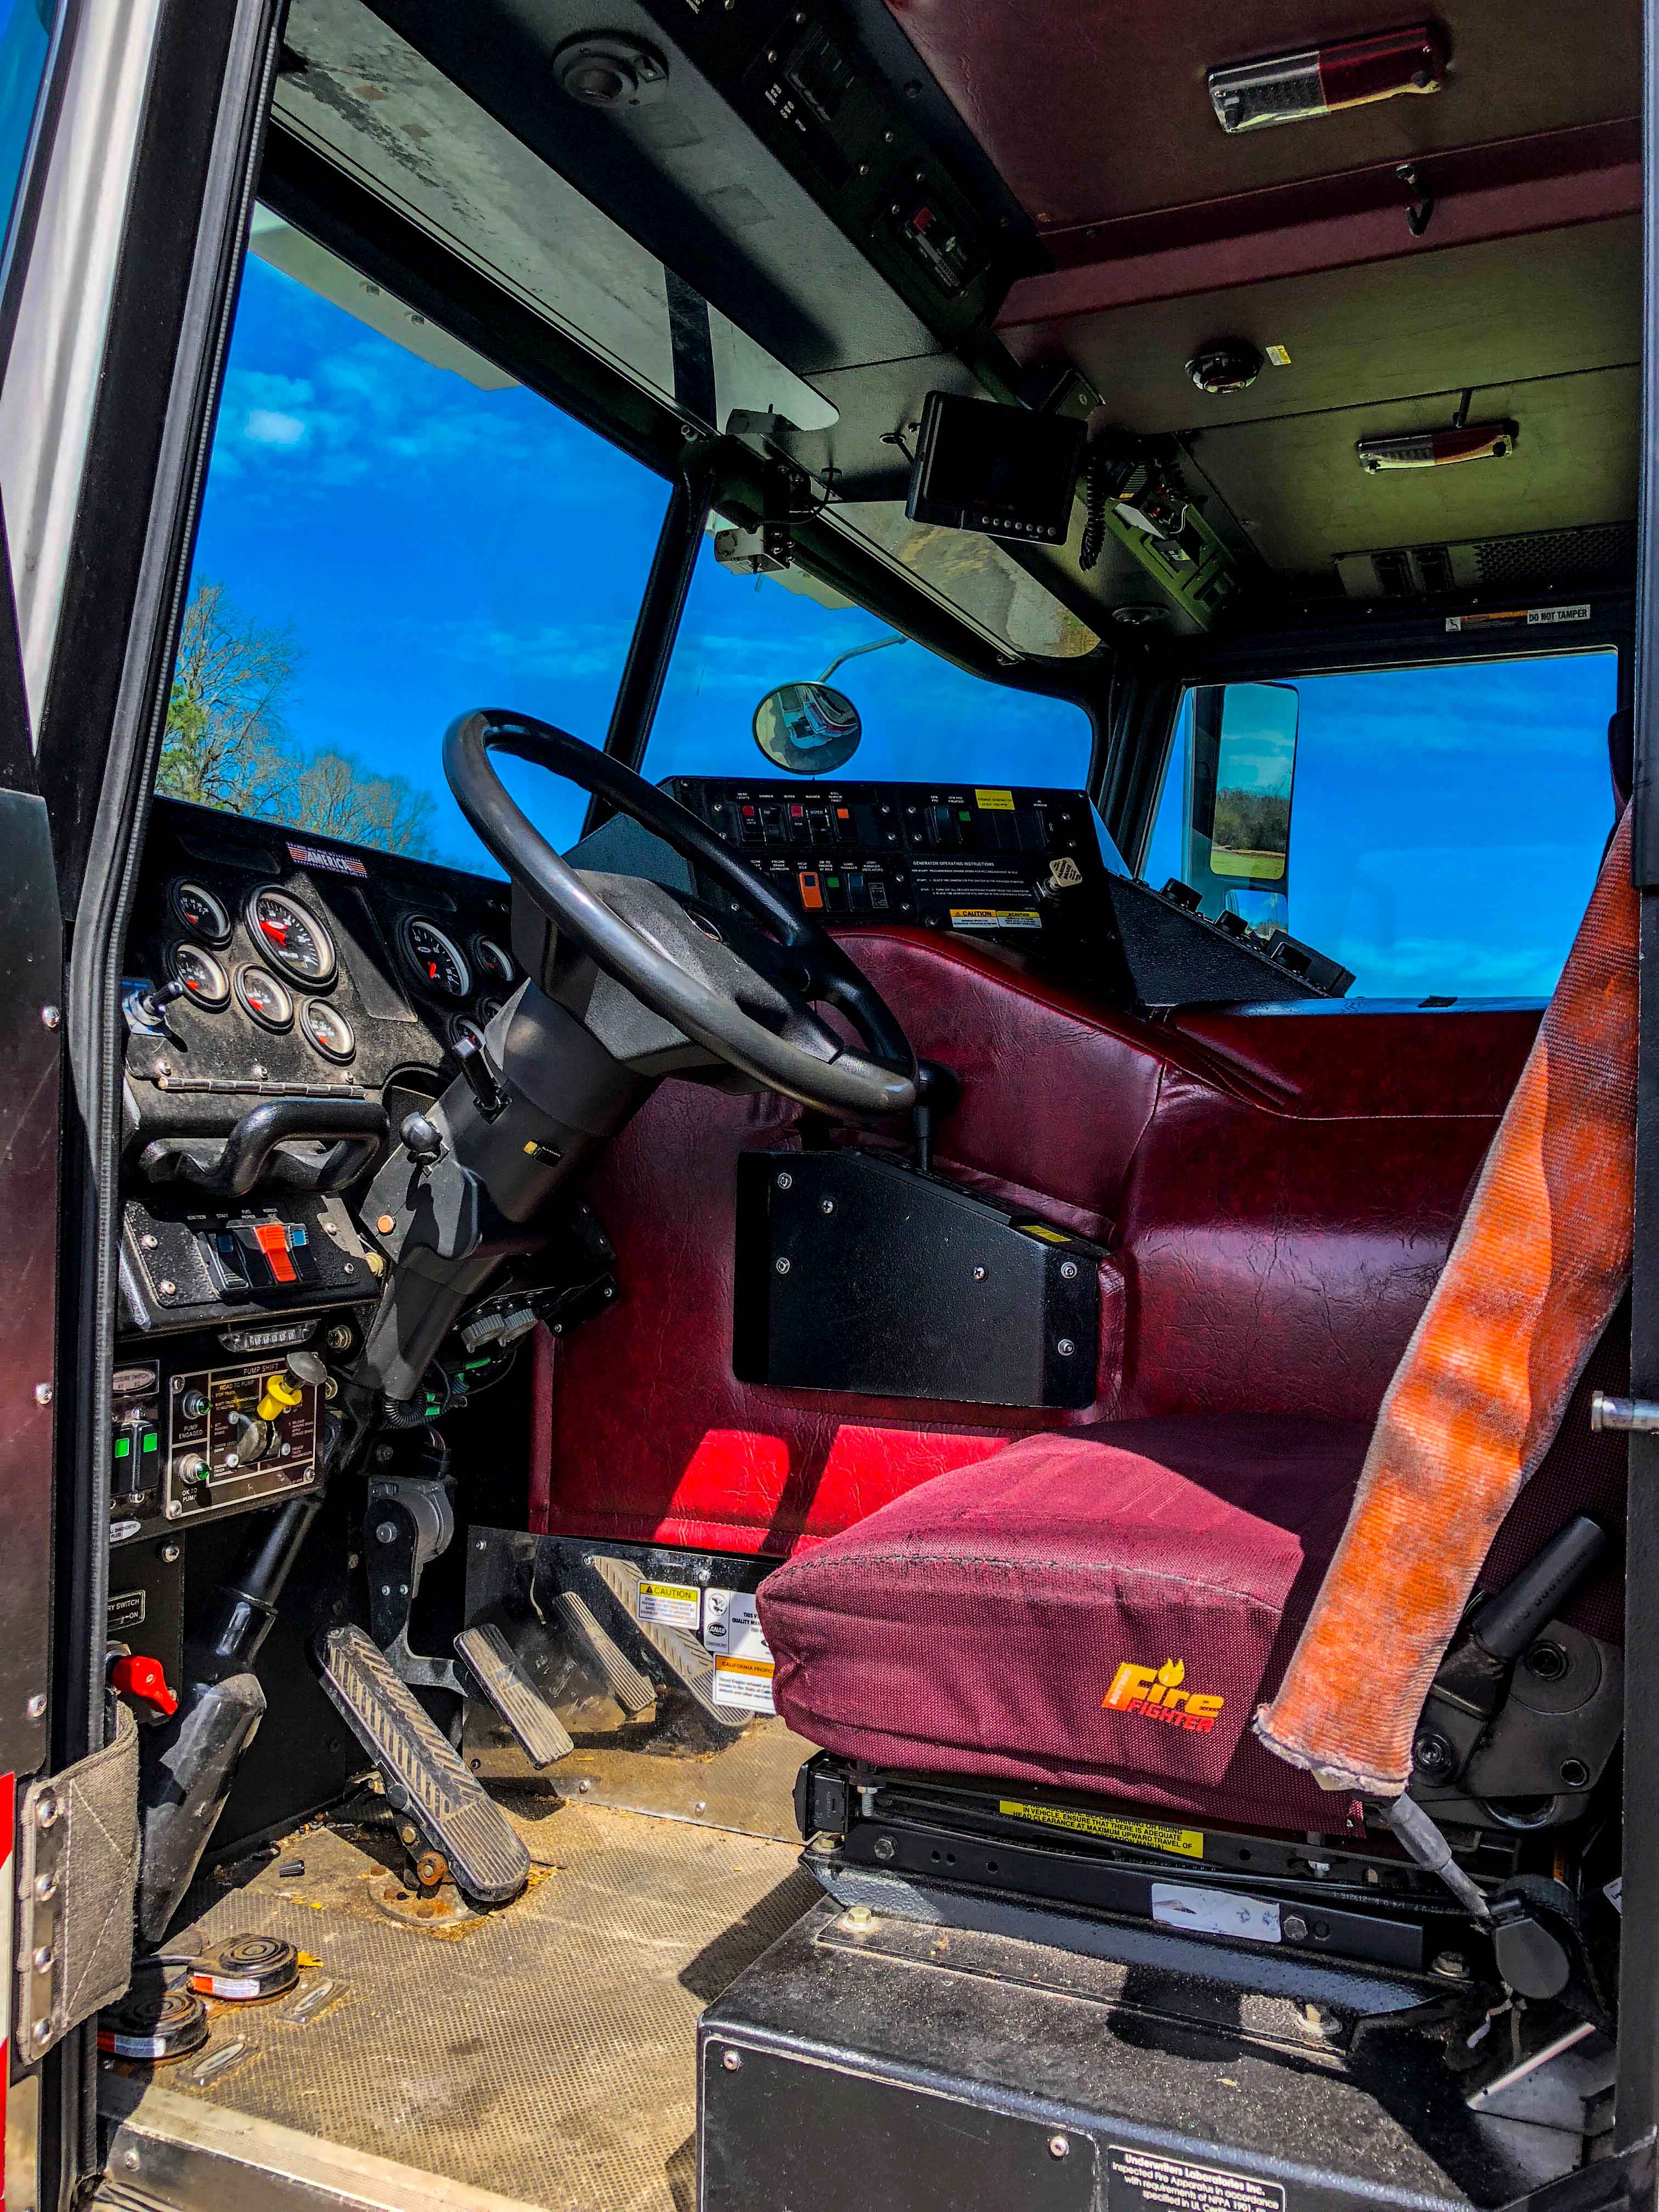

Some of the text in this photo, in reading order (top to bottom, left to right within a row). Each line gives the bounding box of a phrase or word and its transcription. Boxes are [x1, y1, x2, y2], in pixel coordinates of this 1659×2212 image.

[1529, 613, 1538, 622] DO
[1541, 612, 1555, 620] NOT
[1556, 609, 1587, 619] TAMPER
[307, 851, 353, 871] AMERICA
[244, 1363, 279, 1375] PUMP SHIFT
[179, 1430, 203, 1439] ENGAGED
[183, 1494, 198, 1502] PUMP
[654, 1587, 691, 1599] CAUTION
[116, 1599, 140, 1610] SWITCH
[722, 1662, 753, 1670] CALIFORNIA
[1101, 1658, 1224, 1718] Fire
[1126, 1697, 1215, 1733] FIGHTER
[1013, 1812, 1032, 1820] HEAD
[1033, 1815, 1075, 1827] CLEARANCE
[1087, 1824, 1120, 1836] MAXIMUM
[1122, 1831, 1152, 1842] UPWARD
[1154, 1837, 1181, 1848] TRAVEL
[1063, 1814, 1090, 1825] ENSURE
[1091, 1819, 1110, 1828] THAT
[1110, 1823, 1133, 1832] THERE
[1144, 1829, 1182, 1841] ADEQUATE
[1159, 1825, 1182, 1835] RIDING
[1125, 2153, 1266, 2196] Underwriters Laboratories Inc.
[1113, 2161, 1153, 2179] Inspected
[1154, 2171, 1170, 2183] Fire
[1170, 2176, 1214, 2194] Apparatus
[1215, 2186, 1223, 2196] in
[1224, 2190, 1279, 2210] accordance
[1124, 2175, 1142, 2187] with
[1143, 2180, 1197, 2200] requirements
[1198, 2193, 1207, 2202] of
[1208, 2194, 1231, 2209] NFPA
[1142, 2190, 1181, 2207] specified
[1182, 2198, 1189, 2208] in
[1190, 2200, 1201, 2211] UL
